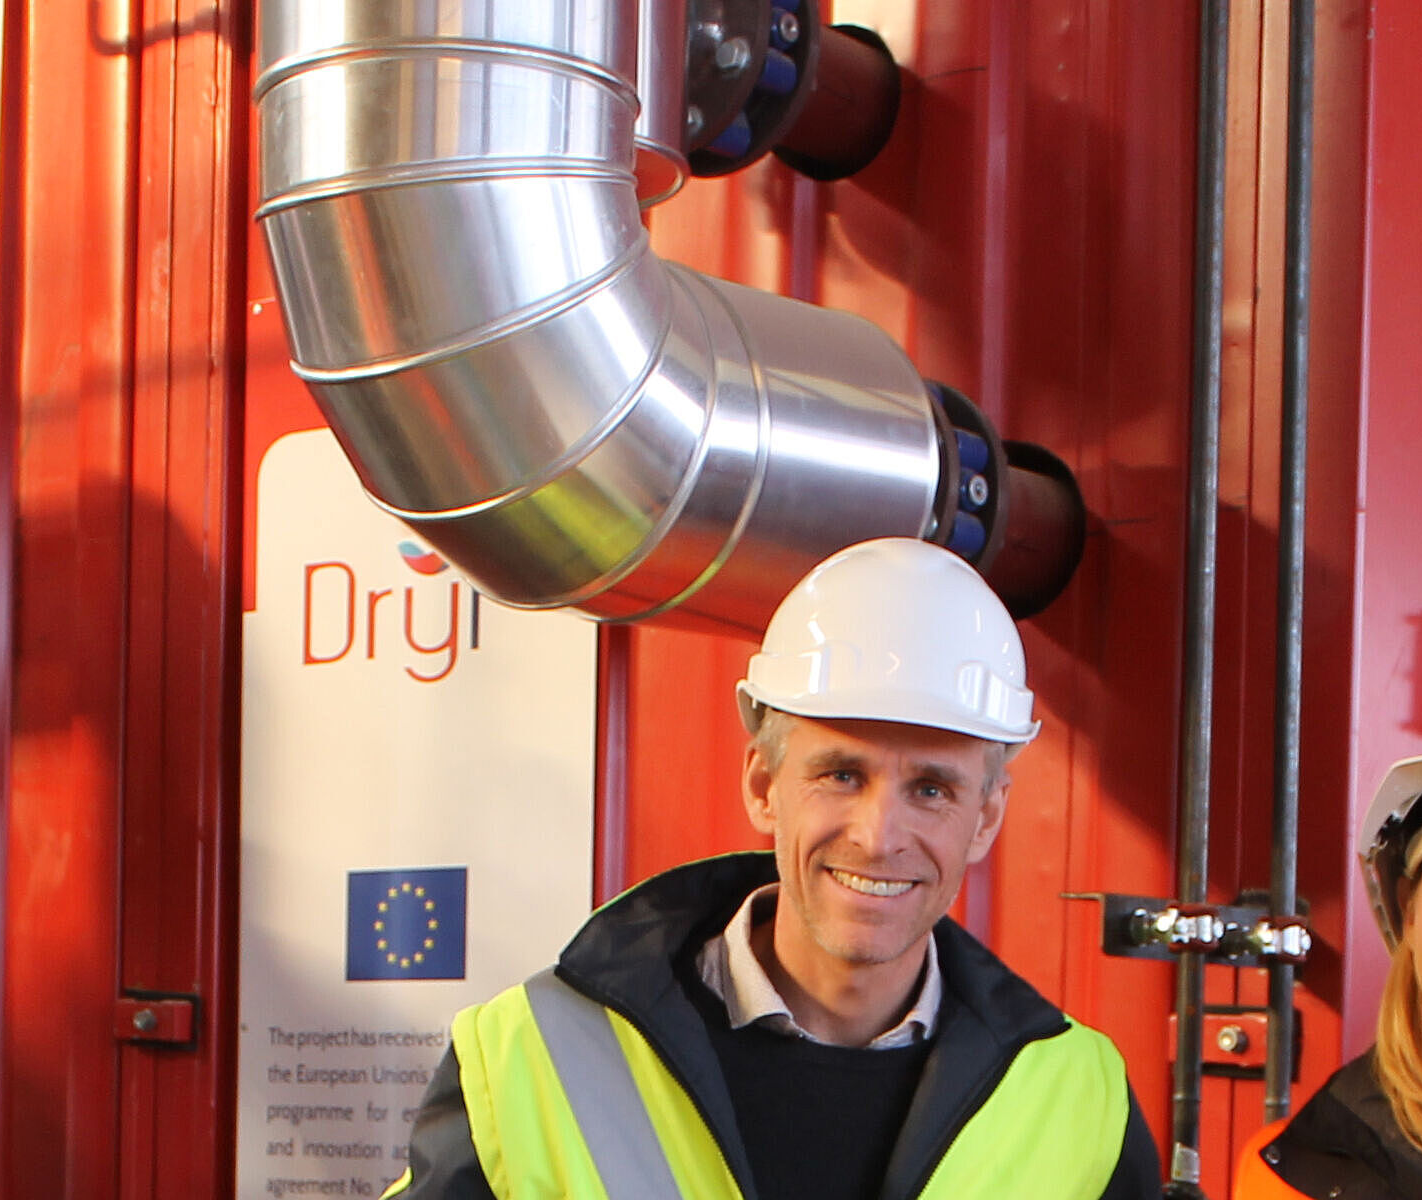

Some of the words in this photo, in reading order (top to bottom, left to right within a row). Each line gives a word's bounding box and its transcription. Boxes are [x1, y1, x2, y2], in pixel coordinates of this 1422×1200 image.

[268, 1027, 295, 1046] The
[297, 1026, 348, 1052] project
[350, 1026, 377, 1047] has
[379, 1026, 445, 1047] received
[267, 1064, 291, 1084] the
[297, 1063, 367, 1089] European
[266, 1104, 354, 1126] programme
[367, 1101, 388, 1122] for
[266, 1138, 294, 1156] and
[303, 1140, 383, 1159] innovation
[265, 1178, 346, 1198] agreement
